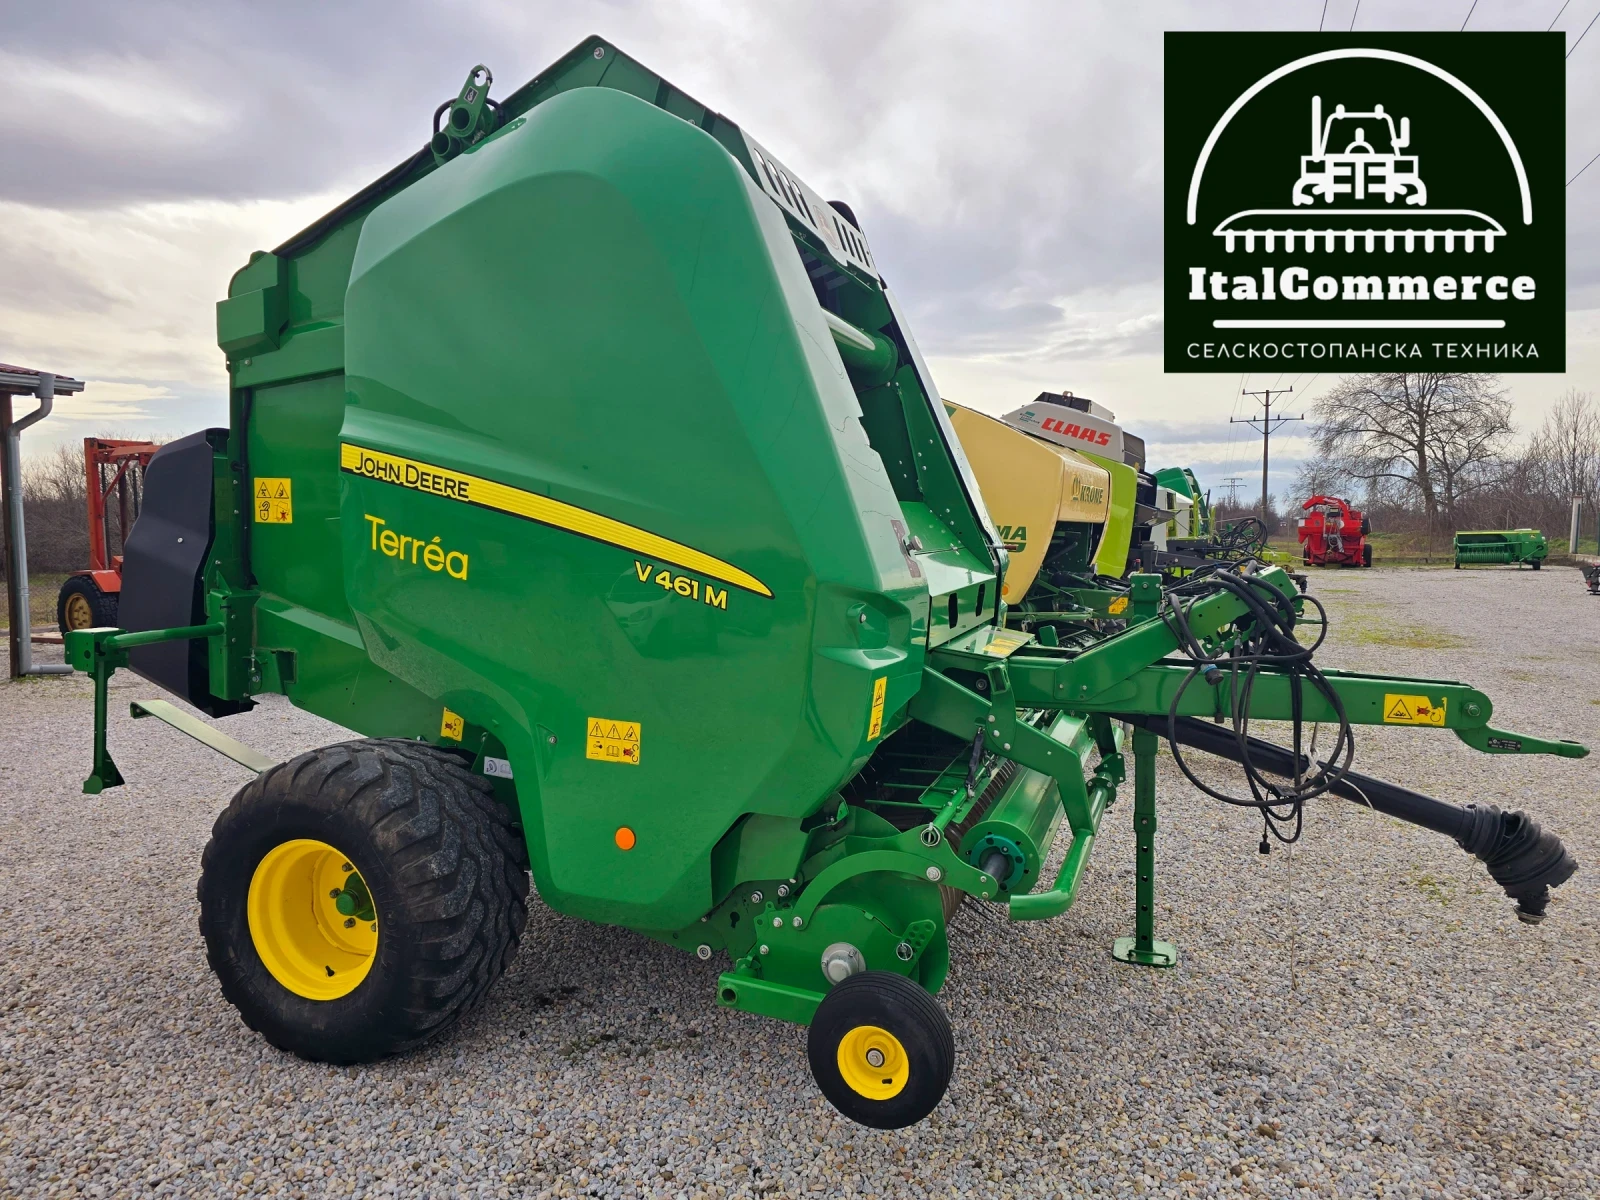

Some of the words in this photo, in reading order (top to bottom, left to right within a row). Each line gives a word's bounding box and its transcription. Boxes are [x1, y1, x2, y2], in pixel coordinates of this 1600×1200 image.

[1041, 417, 1112, 446] CLAAS
[354, 452, 401, 482] JOHN
[405, 463, 470, 499] DEERE
[1080, 485, 1104, 504] KRONE
[364, 513, 469, 581] Terréa
[634, 559, 654, 583] V
[654, 569, 700, 601] 461
[704, 583, 729, 611] M
